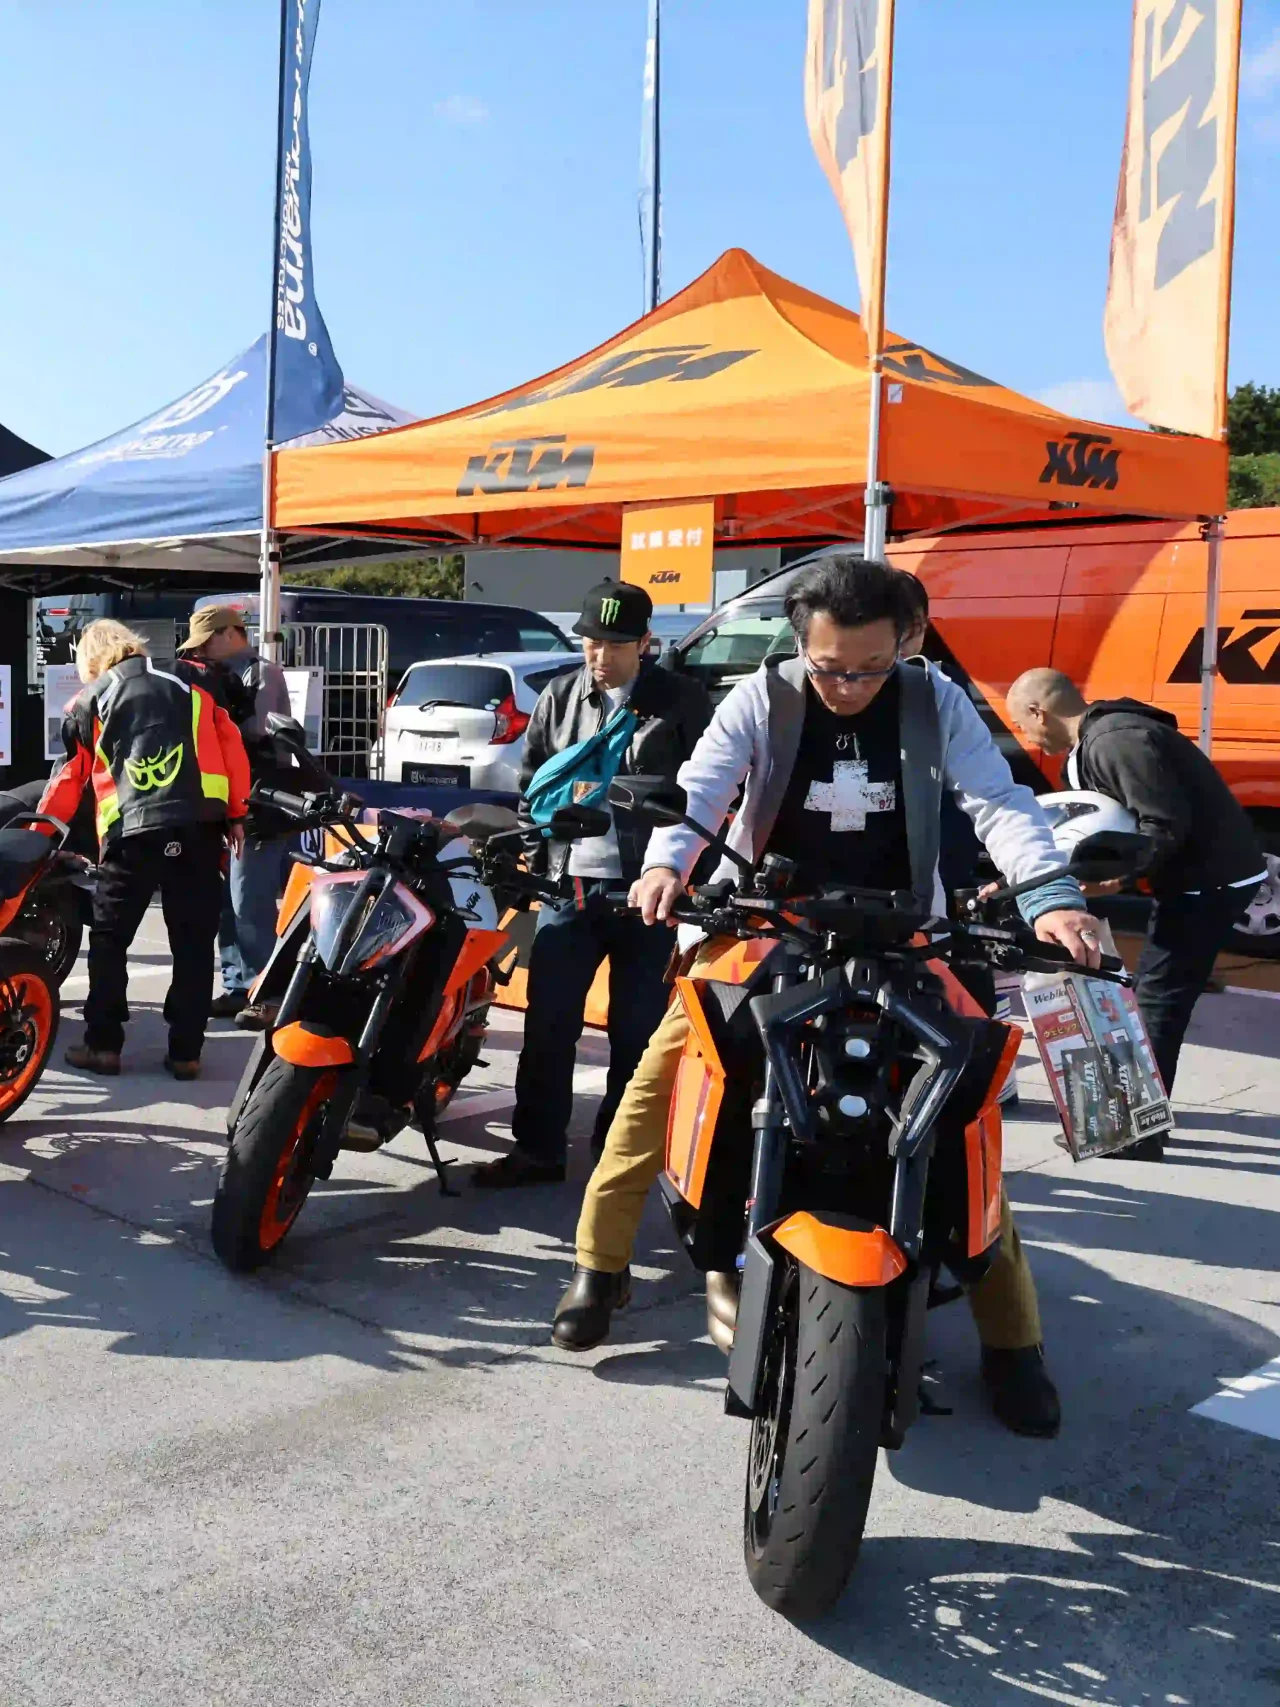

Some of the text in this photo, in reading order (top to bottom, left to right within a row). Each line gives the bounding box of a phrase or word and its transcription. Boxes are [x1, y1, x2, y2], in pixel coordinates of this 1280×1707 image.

[276, 152, 292, 330] MOTORCYCLES
[456, 434, 596, 497] KTM
[648, 570, 681, 584] KTM
